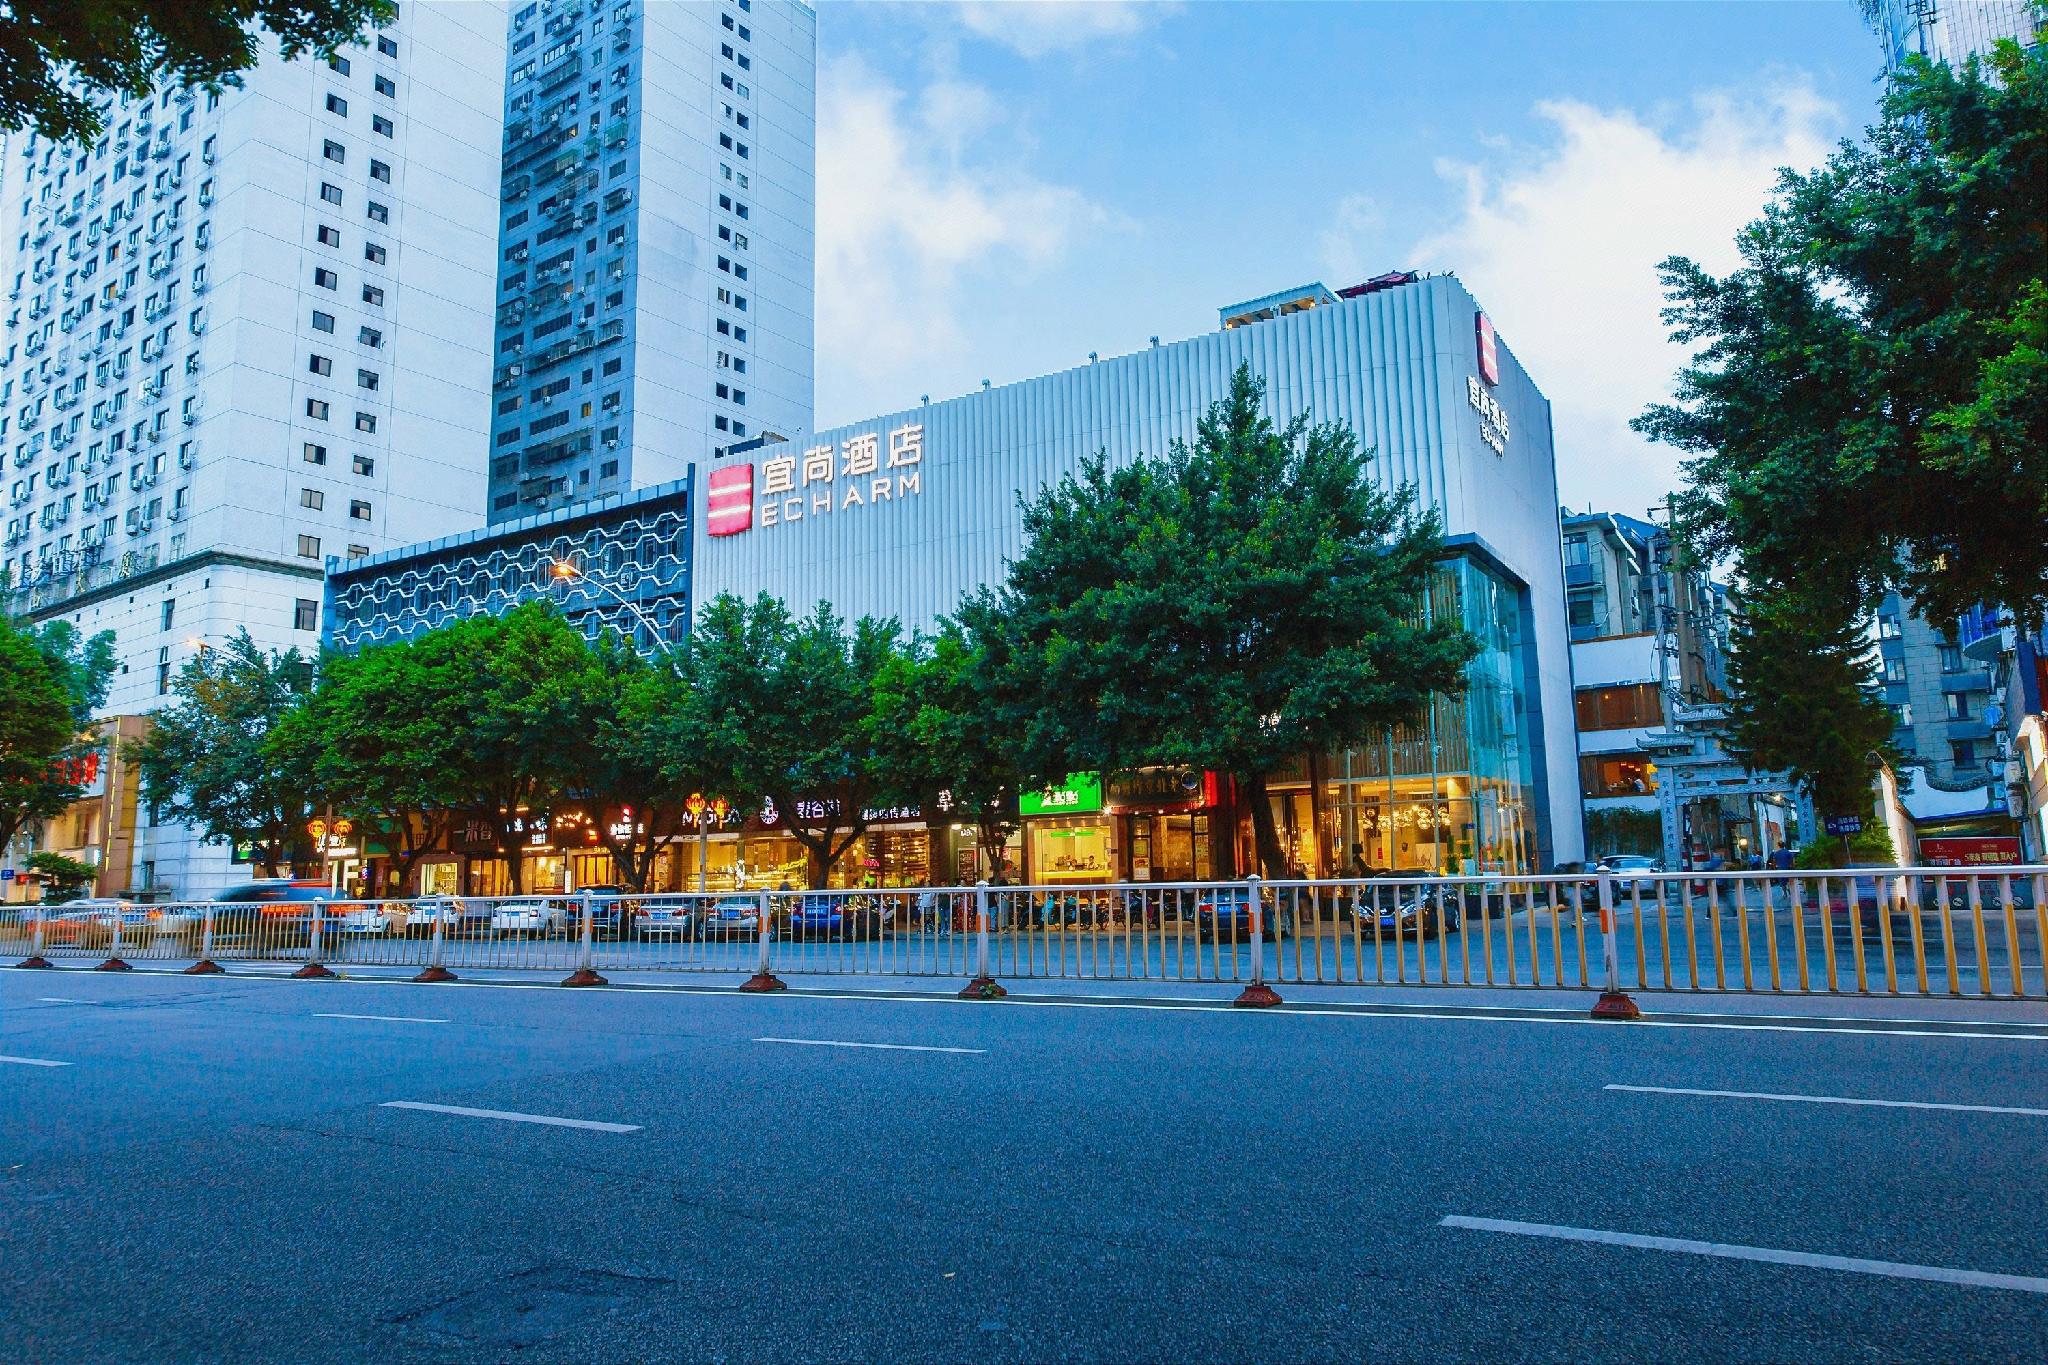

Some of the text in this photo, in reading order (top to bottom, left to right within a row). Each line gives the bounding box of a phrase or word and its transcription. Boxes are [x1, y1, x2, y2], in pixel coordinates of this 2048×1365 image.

[761, 424, 924, 496] 宜尚酒店
[761, 472, 921, 528] ECHARM
